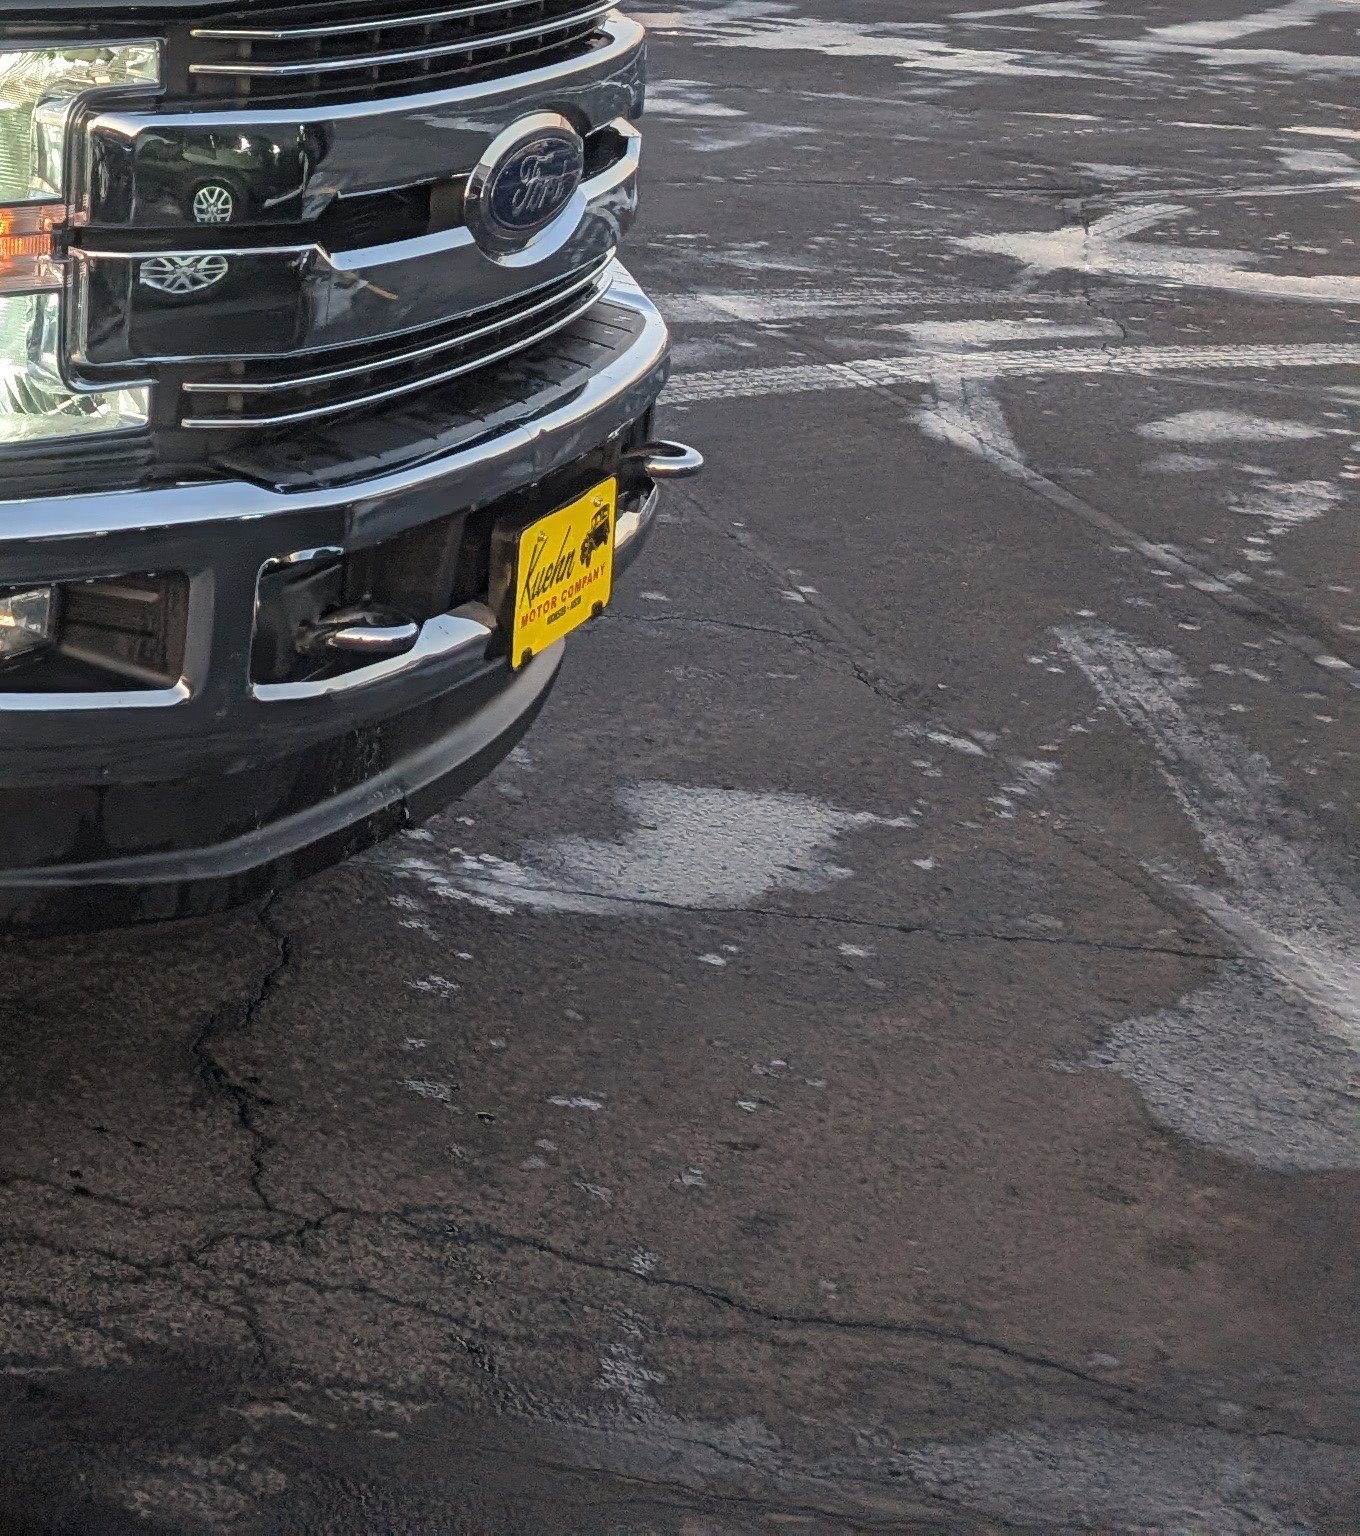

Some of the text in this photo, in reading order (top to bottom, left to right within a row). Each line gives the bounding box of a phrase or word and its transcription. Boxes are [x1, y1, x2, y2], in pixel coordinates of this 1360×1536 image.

[511, 153, 571, 216] Ford
[519, 525, 575, 610] Kuehn
[520, 595, 558, 629] MOTOR
[560, 561, 606, 603] COMPANY
